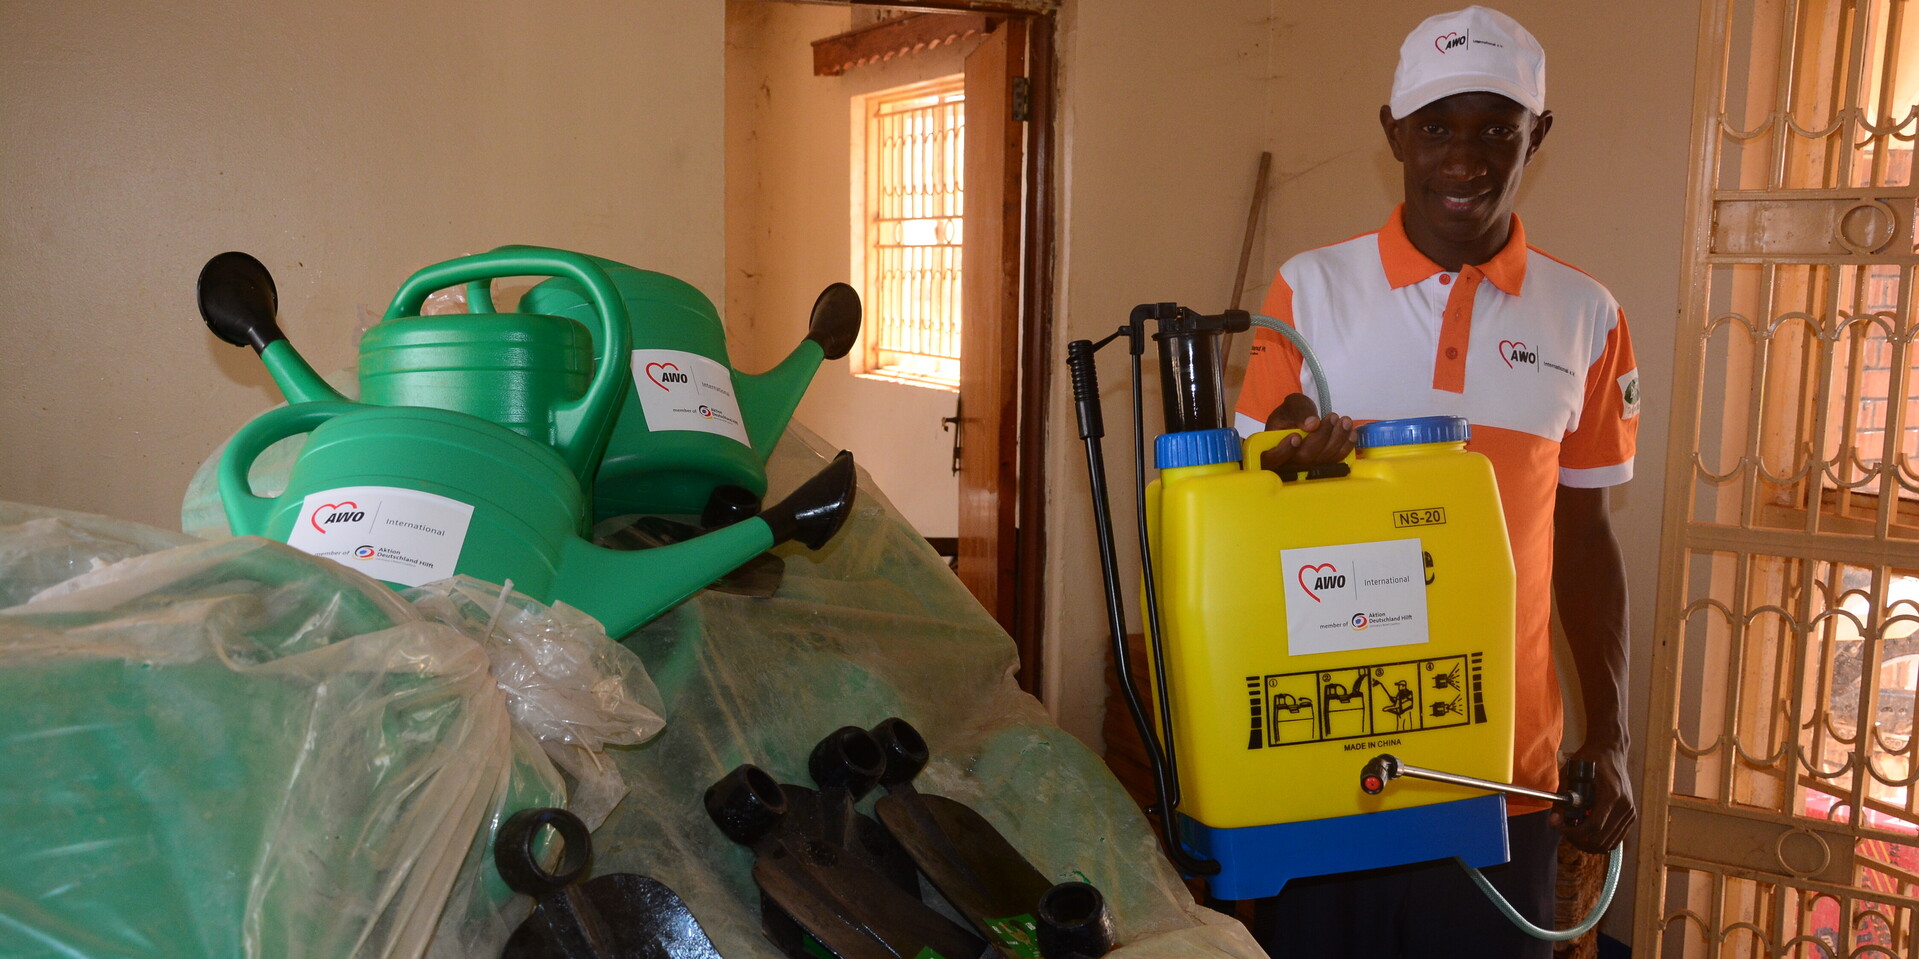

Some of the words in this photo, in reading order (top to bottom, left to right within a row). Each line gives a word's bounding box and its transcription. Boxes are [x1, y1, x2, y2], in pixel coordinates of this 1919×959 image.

[1445, 36, 1465, 50] AWO
[1511, 350, 1536, 364] AWO
[662, 372, 688, 383] AWO
[324, 511, 365, 524] AWO
[1400, 511, 1440, 525] NS-20
[386, 518, 446, 537] International
[377, 552, 419, 564] Deutschland
[1314, 575, 1346, 590] AWO
[1364, 576, 1410, 586] International
[1344, 742, 1366, 752] MADE
[1377, 739, 1401, 748] CHINA
